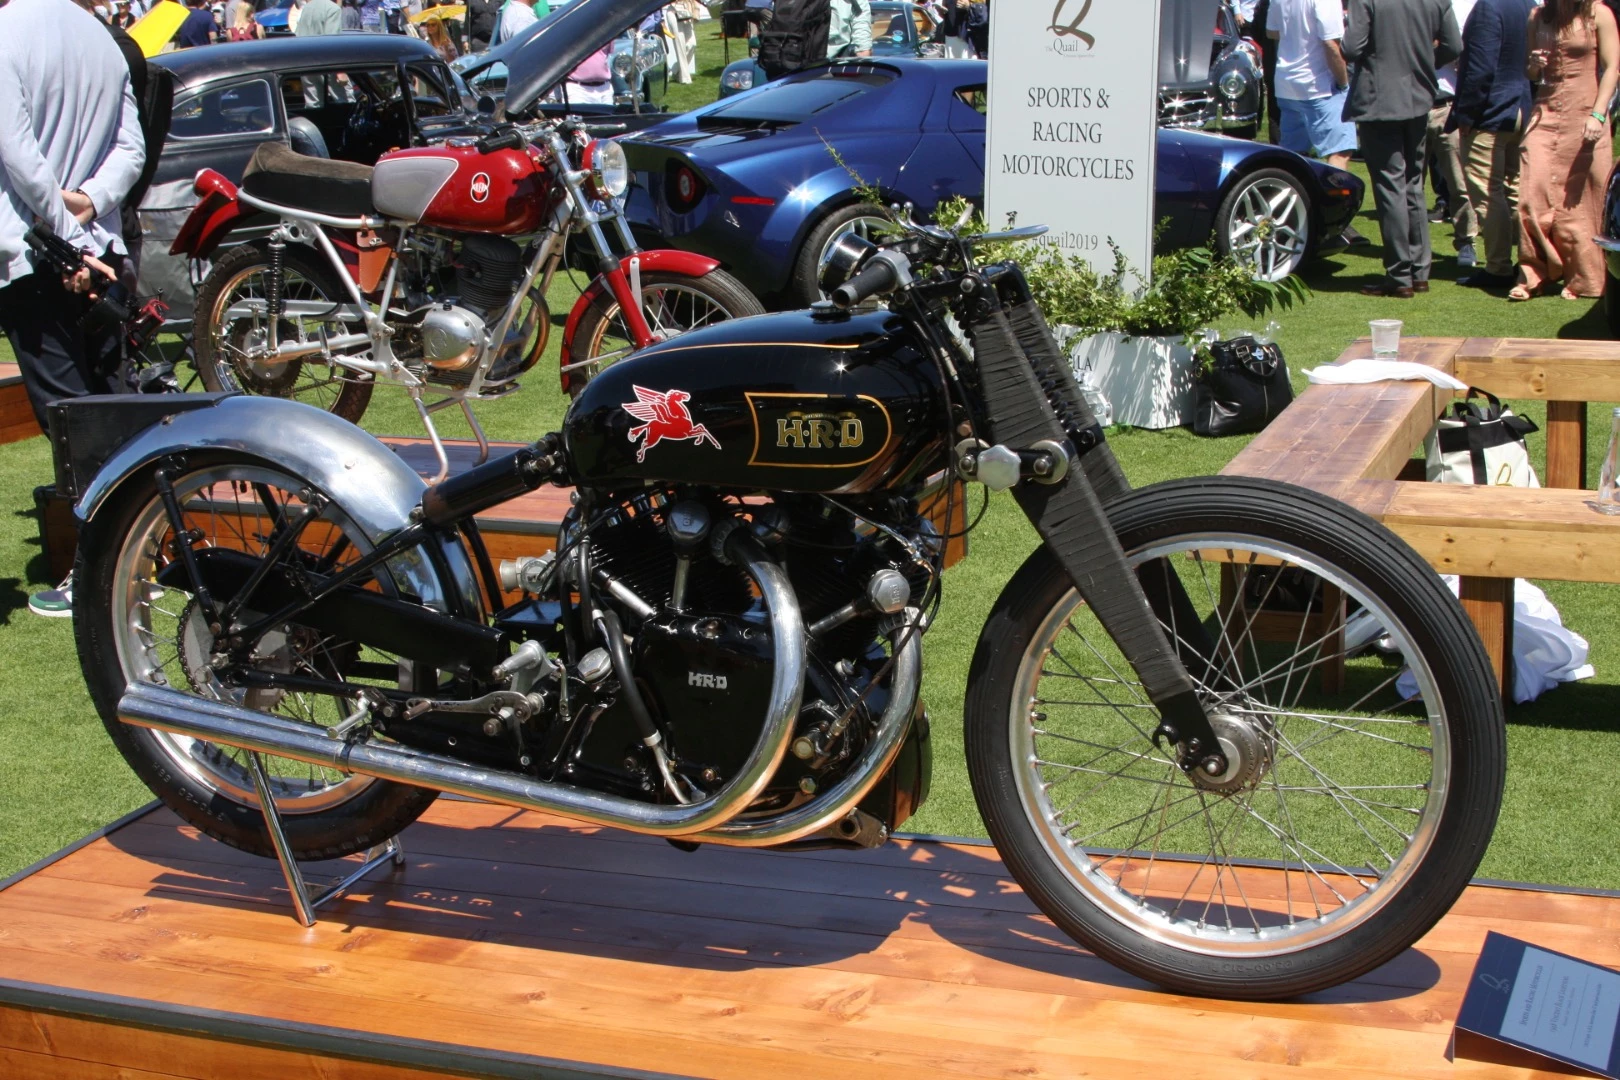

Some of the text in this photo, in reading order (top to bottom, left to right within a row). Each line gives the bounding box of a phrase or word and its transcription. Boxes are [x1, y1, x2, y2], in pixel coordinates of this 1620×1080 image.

[1053, 38, 1078, 56] Quail
[1028, 87, 1111, 109] SPORTS &
[1032, 121, 1103, 144] RACING
[1002, 154, 1134, 181] MOTORCYCLES
